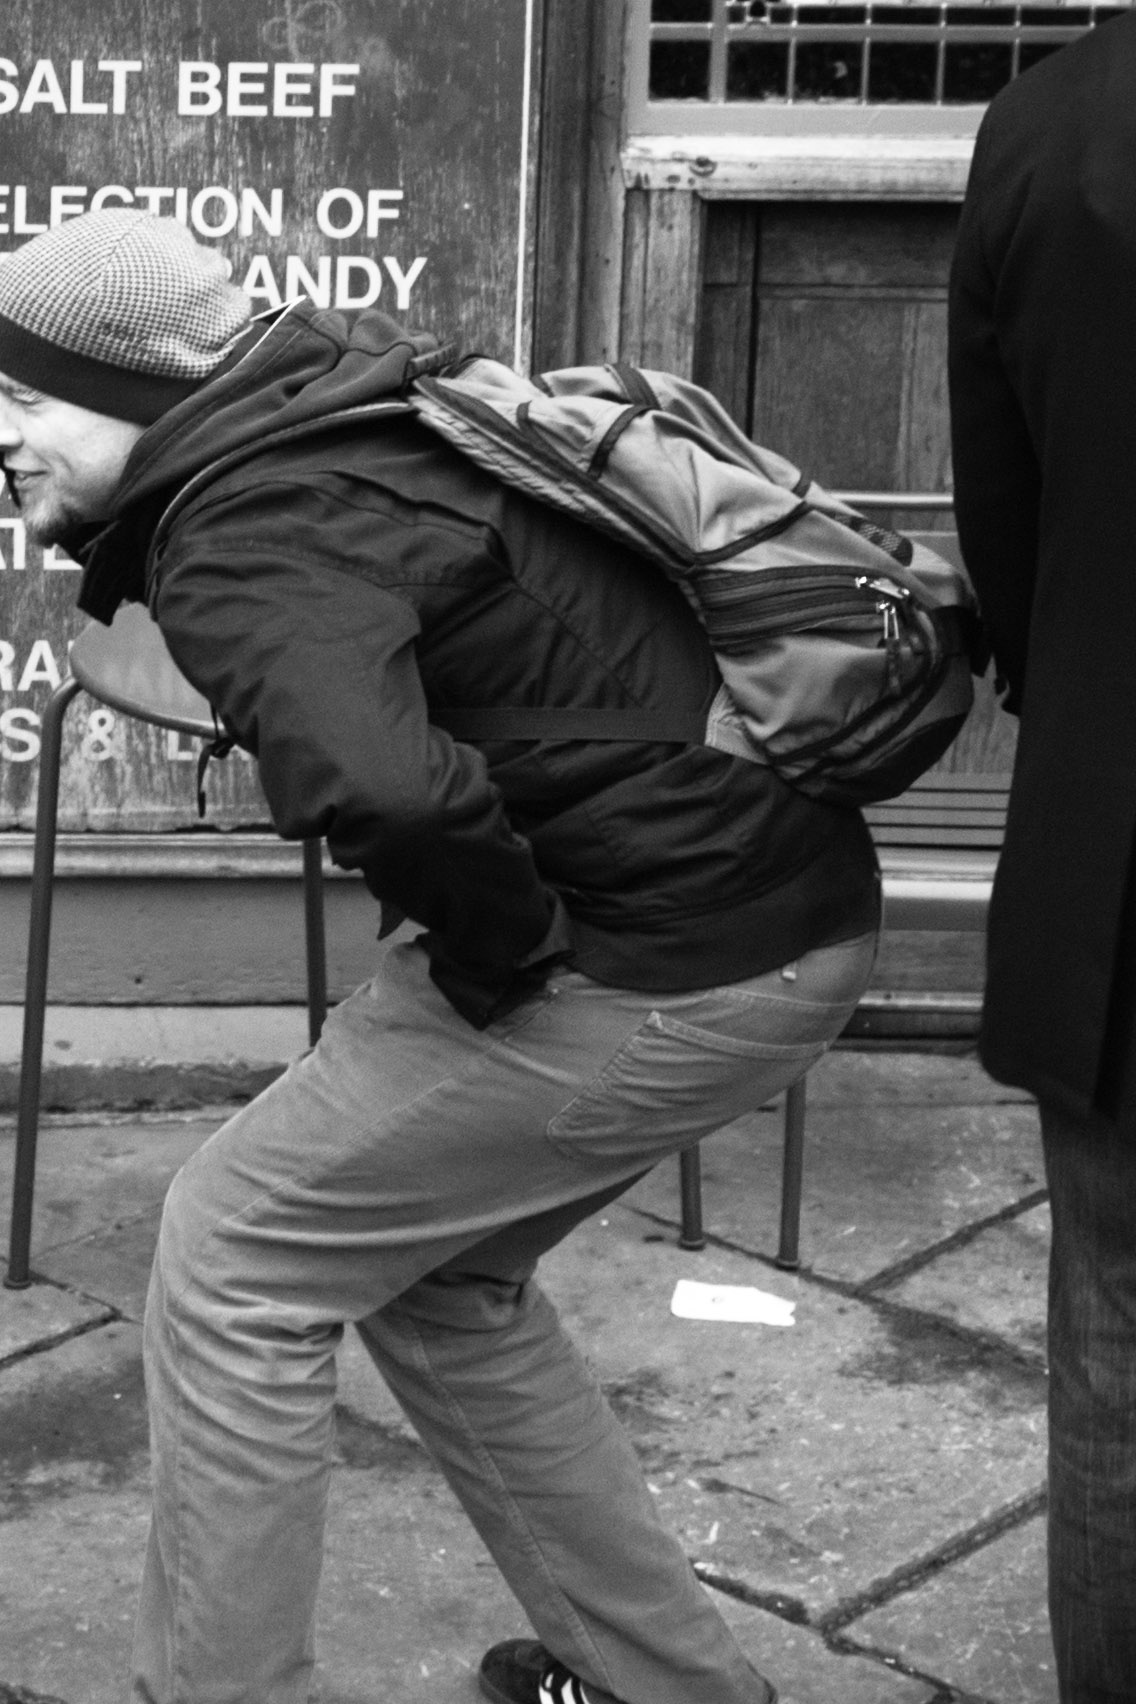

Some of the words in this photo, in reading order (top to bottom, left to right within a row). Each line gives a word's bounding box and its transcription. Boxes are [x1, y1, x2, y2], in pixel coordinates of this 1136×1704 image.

[178, 61, 360, 118] BEEF
[316, 187, 404, 239] OF
[81, 709, 117, 762] &
